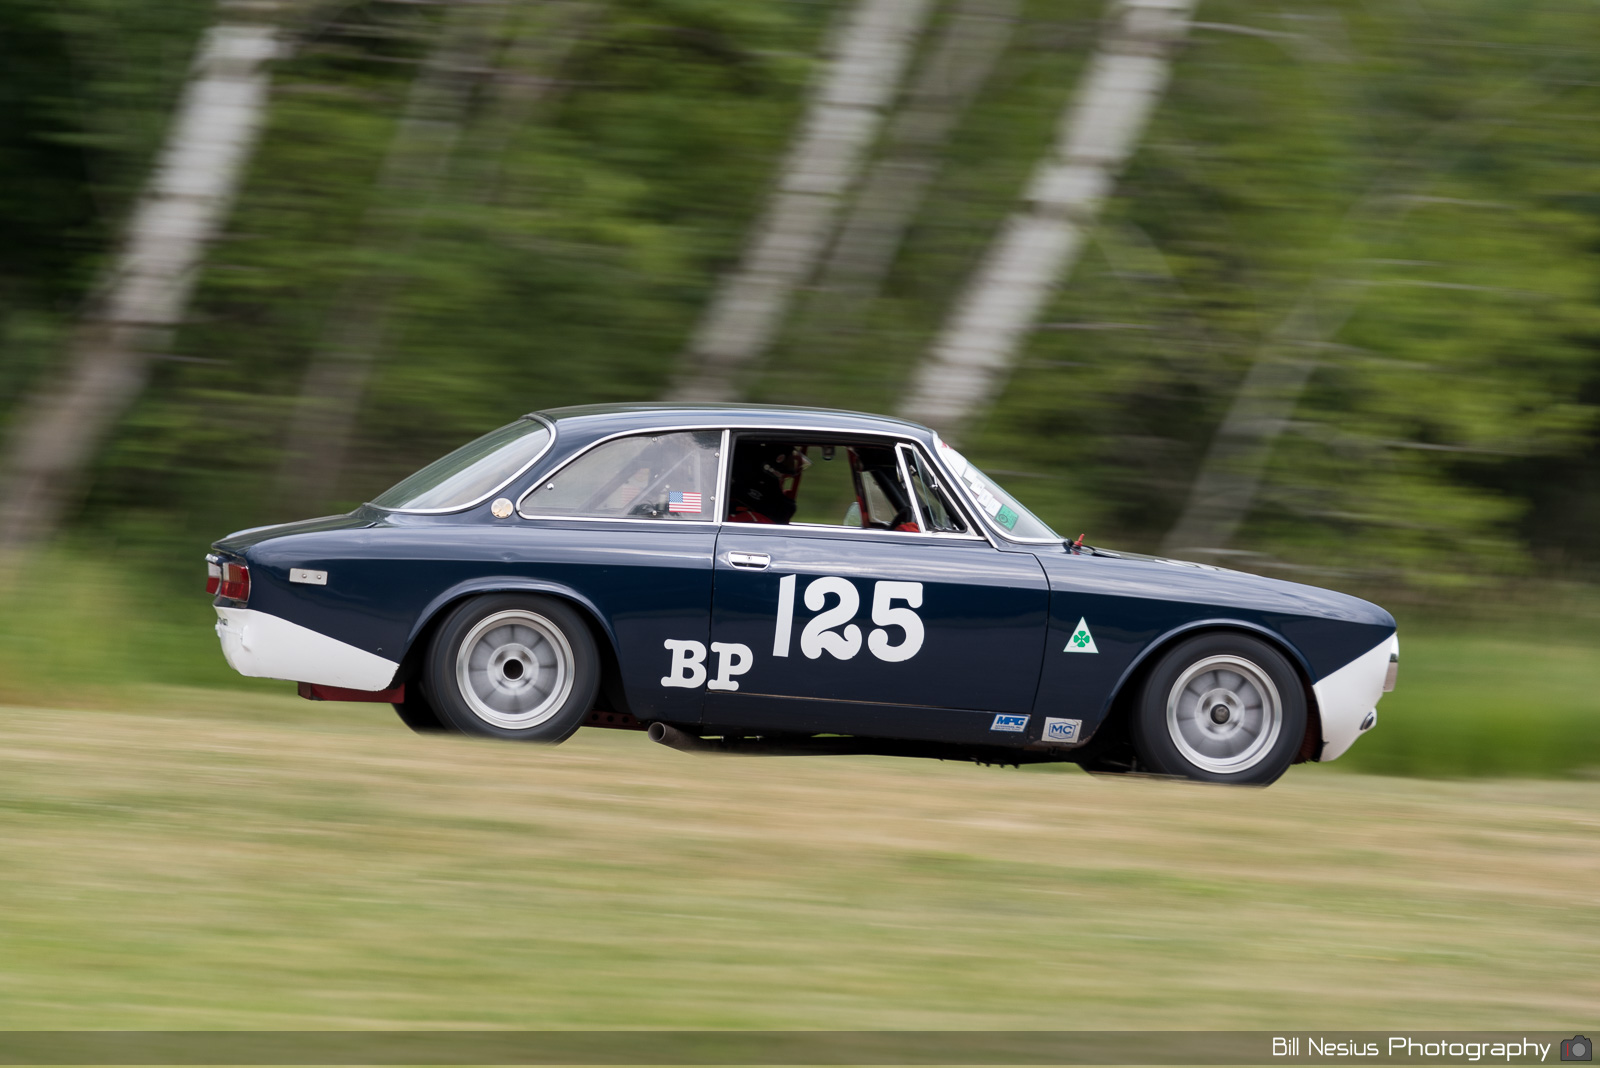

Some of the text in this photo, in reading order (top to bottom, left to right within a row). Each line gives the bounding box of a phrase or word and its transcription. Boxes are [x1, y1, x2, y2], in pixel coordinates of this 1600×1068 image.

[773, 574, 925, 662] 125
[660, 638, 754, 692] BP
[996, 716, 1026, 726] MPG
[1052, 724, 1072, 734] MC
